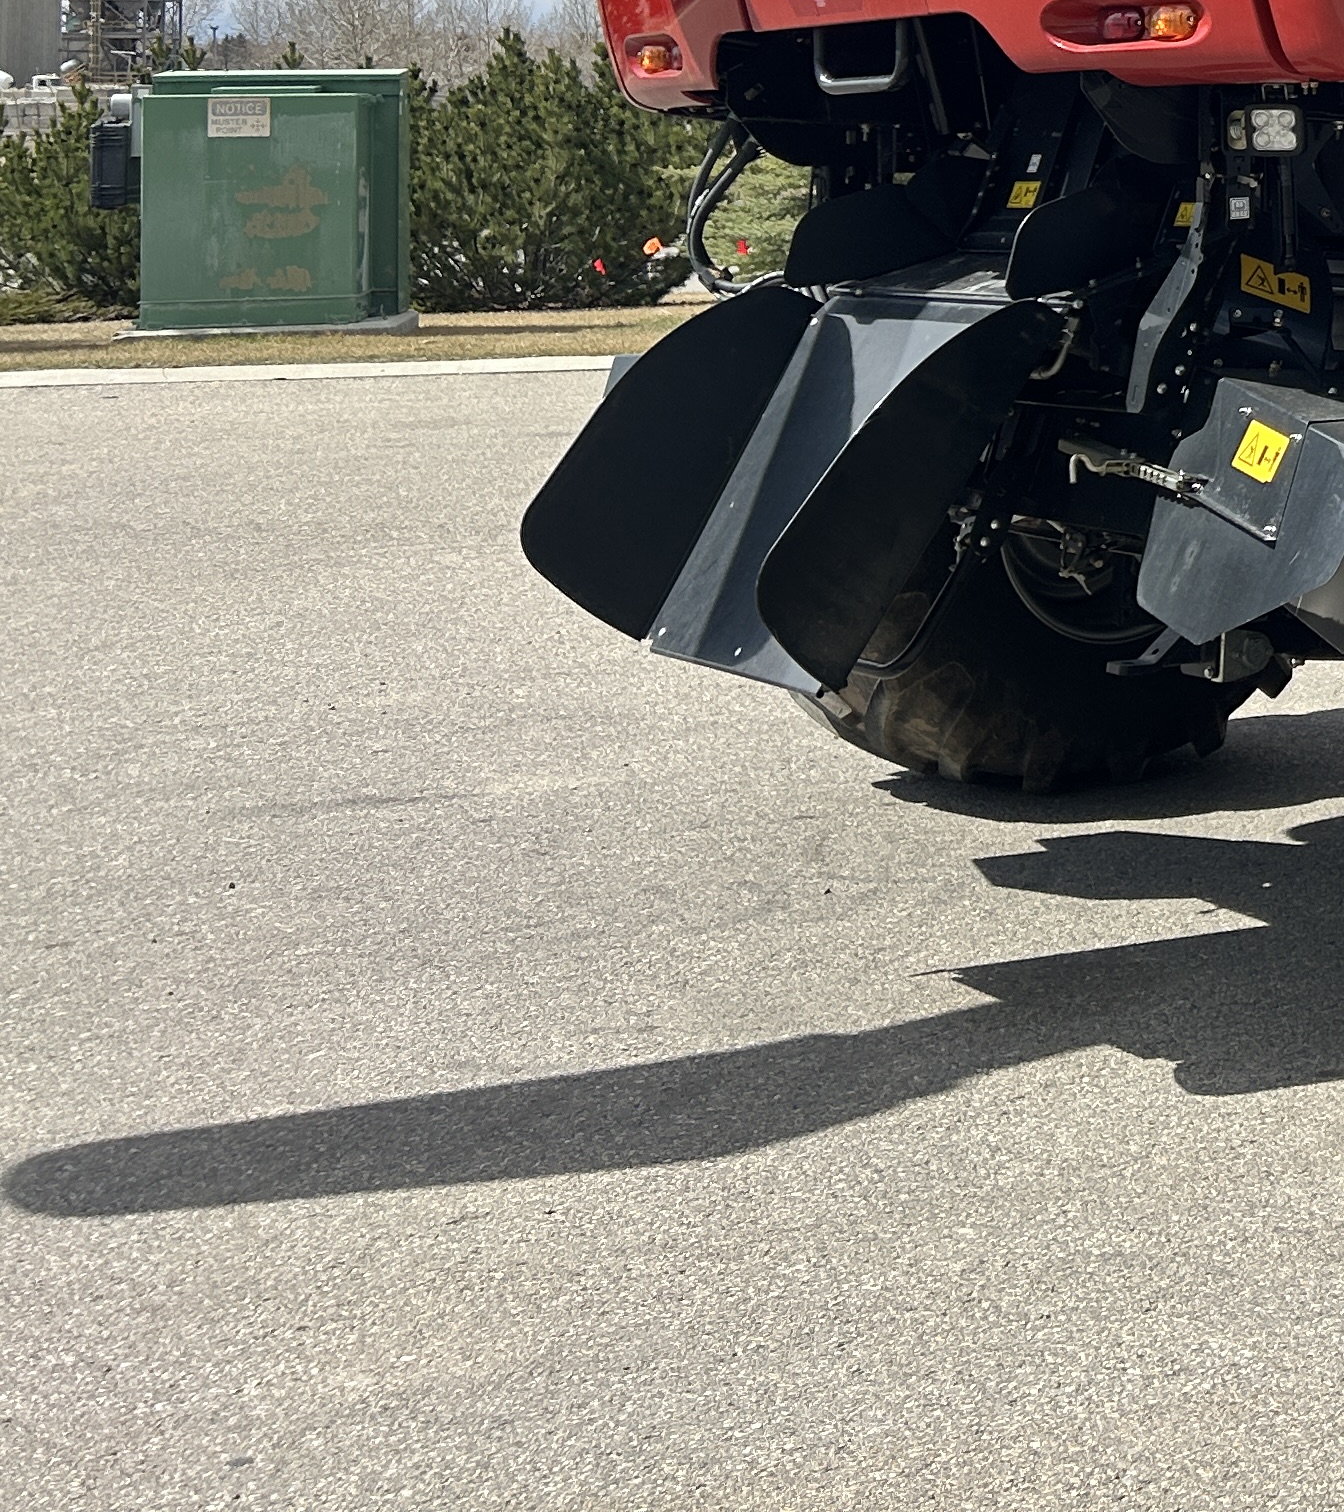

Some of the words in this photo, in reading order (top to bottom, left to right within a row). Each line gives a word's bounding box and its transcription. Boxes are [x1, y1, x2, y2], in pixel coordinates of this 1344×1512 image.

[216, 102, 263, 115] NOTICE
[211, 117, 248, 126] MUSTER
[215, 126, 243, 134] POINT
